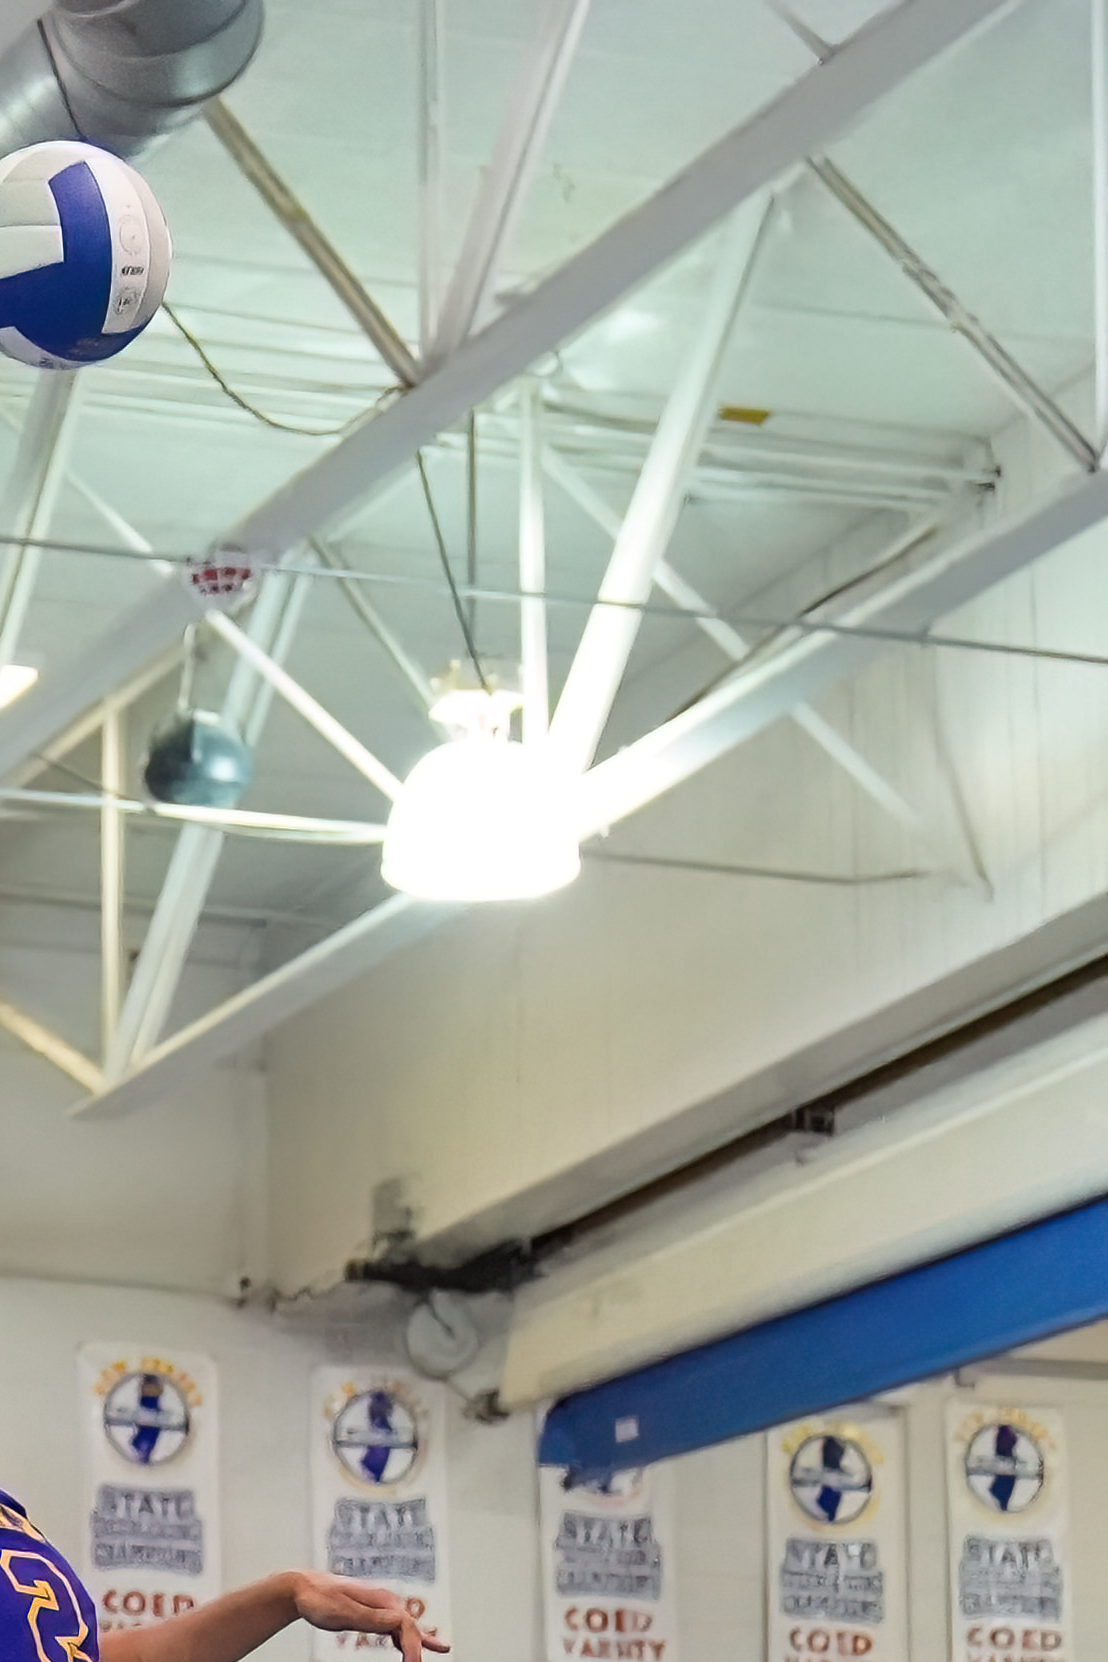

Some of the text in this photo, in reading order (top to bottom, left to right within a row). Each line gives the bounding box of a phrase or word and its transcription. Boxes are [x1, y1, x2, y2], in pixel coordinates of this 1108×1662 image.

[103, 1590, 195, 1617] COED
[565, 1606, 653, 1633] COED
[790, 1627, 873, 1656] COED
[967, 1627, 1062, 1651] COED
